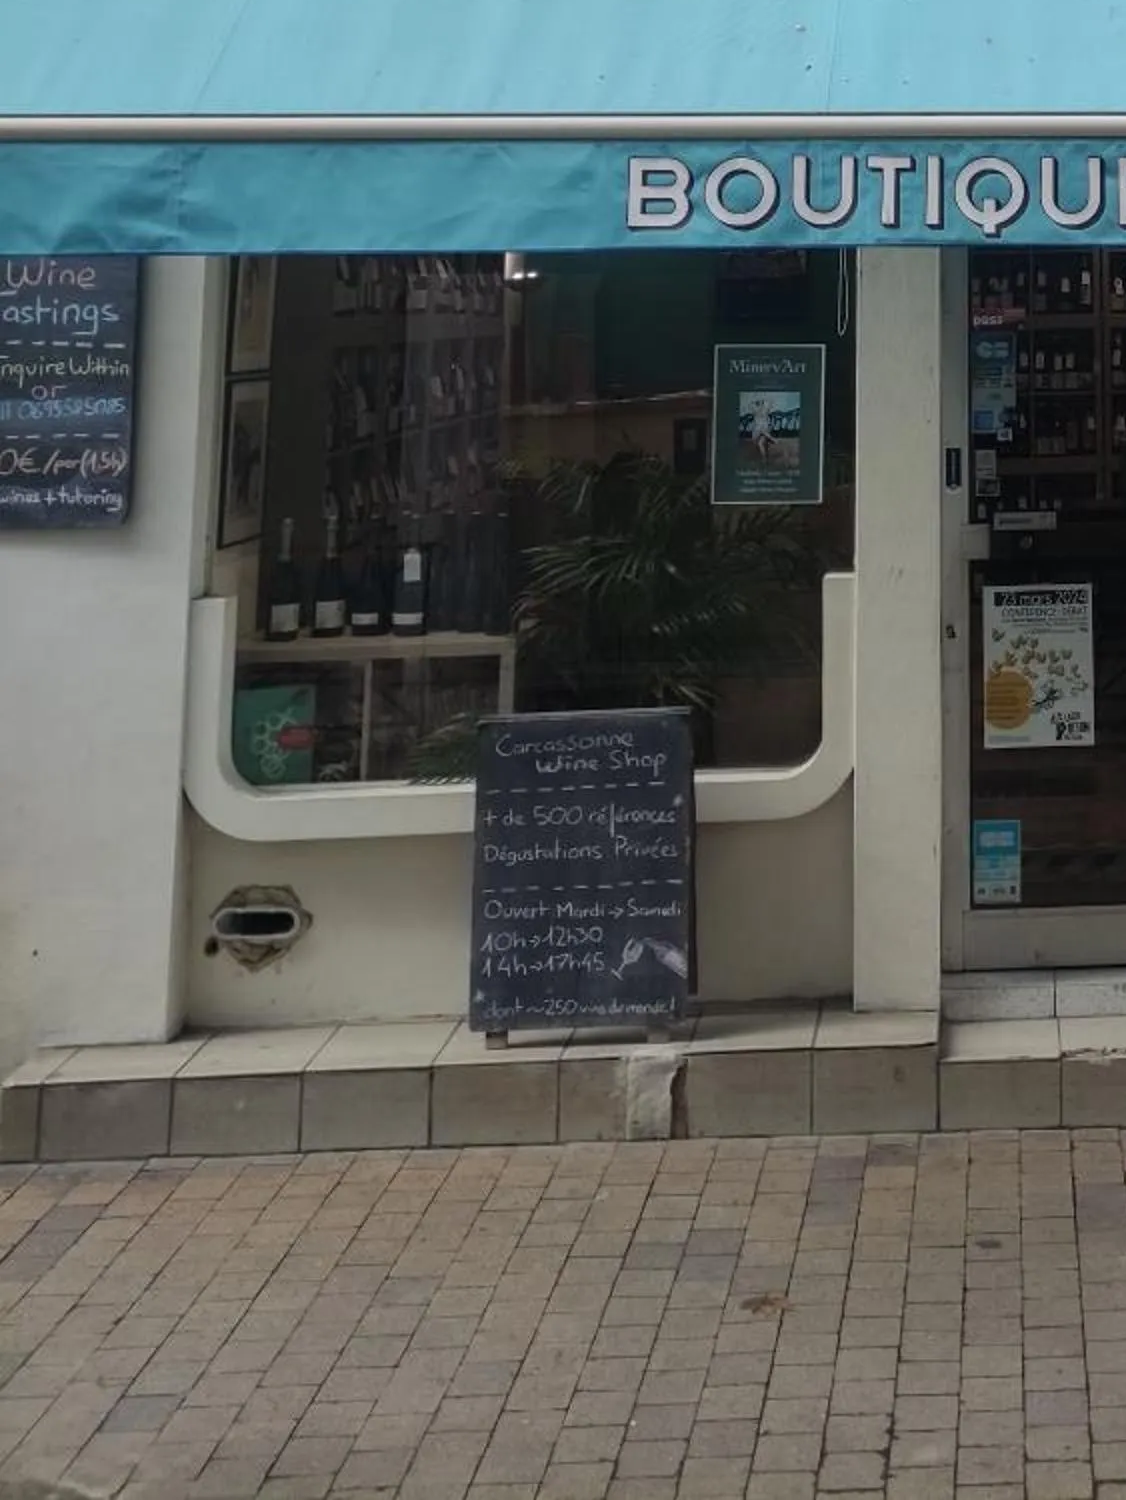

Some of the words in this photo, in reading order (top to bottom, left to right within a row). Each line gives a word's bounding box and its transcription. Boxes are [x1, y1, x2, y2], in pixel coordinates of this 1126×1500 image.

[7, 258, 97, 288] Wine
[0, 290, 121, 336] astings
[0, 355, 66, 389] nquire
[31, 385, 68, 399] or
[495, 732, 634, 757] Carcassonne
[535, 755, 601, 774] Wine
[609, 749, 668, 778] Shop
[502, 808, 526, 827] de
[533, 805, 583, 827] 500
[614, 835, 679, 860] Privées
[483, 898, 550, 920] Ouvert
[555, 901, 606, 918] Mardi
[626, 897, 682, 918] Samedi
[480, 931, 527, 954] 10h
[541, 925, 604, 948] 12h30
